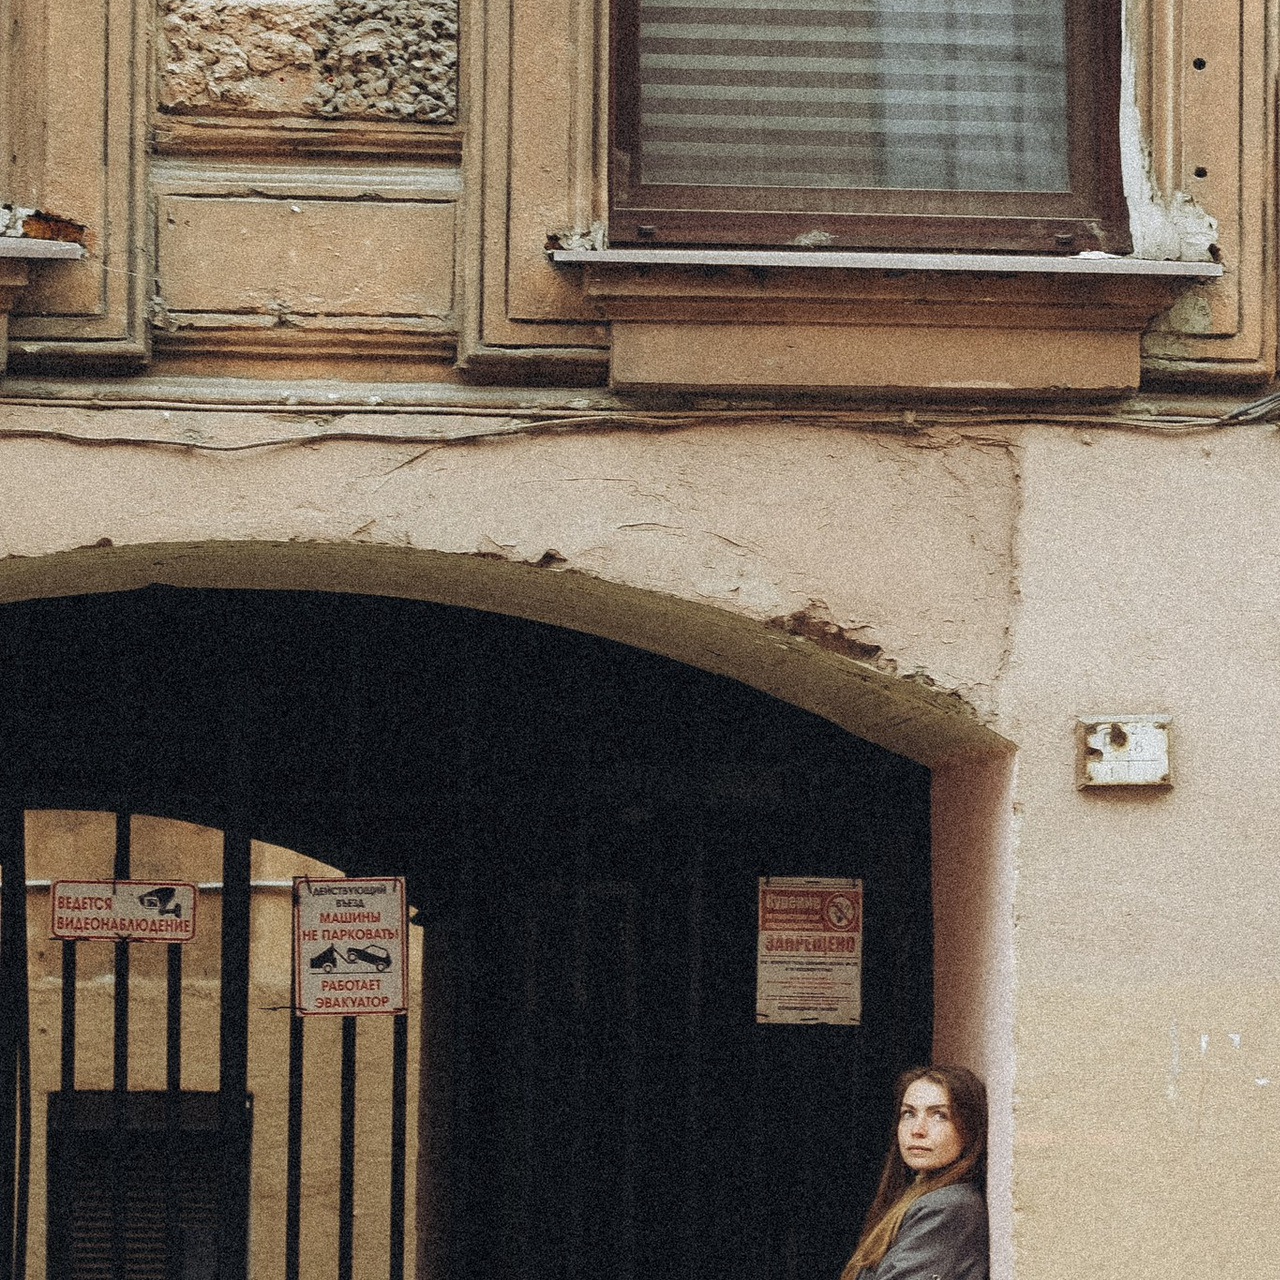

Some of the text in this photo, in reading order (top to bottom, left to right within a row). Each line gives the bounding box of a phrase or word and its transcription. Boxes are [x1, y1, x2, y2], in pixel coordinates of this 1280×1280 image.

[312, 885, 387, 897] ДЕЙСТВУЮЩИЙ
[57, 895, 113, 911] ВЕДЕТСЯ
[335, 899, 365, 908] ВЪЕЗД
[319, 911, 381, 924] МАШИНЫ
[56, 916, 190, 934] ВИДЕОНАБЛЮДЕНИЕ
[302, 928, 399, 941] НЕ ПАРКОВАТЬ!
[764, 934, 856, 954] ЗАПРЕЩЕНО
[321, 980, 381, 991] РАБОТАЕТ
[315, 996, 389, 1008] ЭВАКУАТОР
